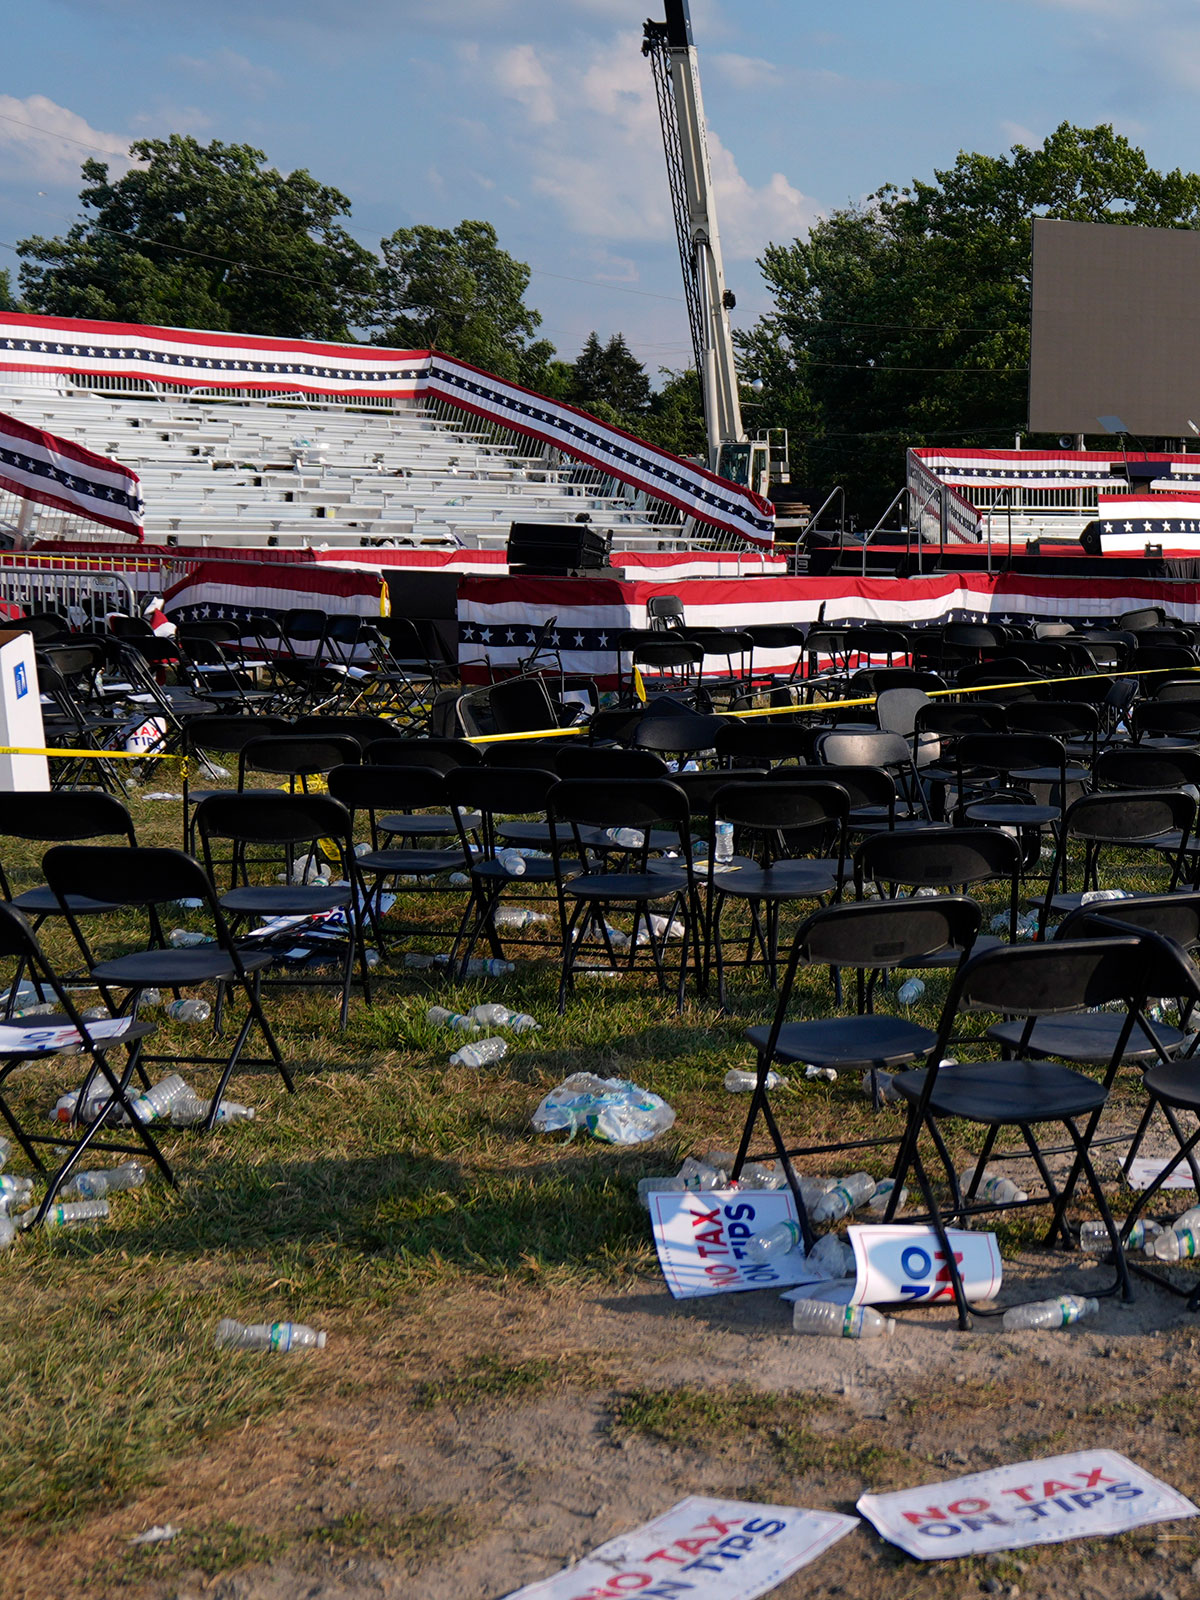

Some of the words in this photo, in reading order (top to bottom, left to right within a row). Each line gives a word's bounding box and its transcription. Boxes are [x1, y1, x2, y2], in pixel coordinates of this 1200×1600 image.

[690, 1208, 729, 1259] TAX
[705, 1264, 745, 1287] NO
[739, 1263, 780, 1283] ON
[902, 1497, 990, 1525] NO
[1001, 1466, 1120, 1502] TAX
[917, 1512, 1009, 1538] ON
[1014, 1481, 1144, 1518] TIPS
[642, 1514, 746, 1565] TAX
[681, 1517, 787, 1574] TIPS
